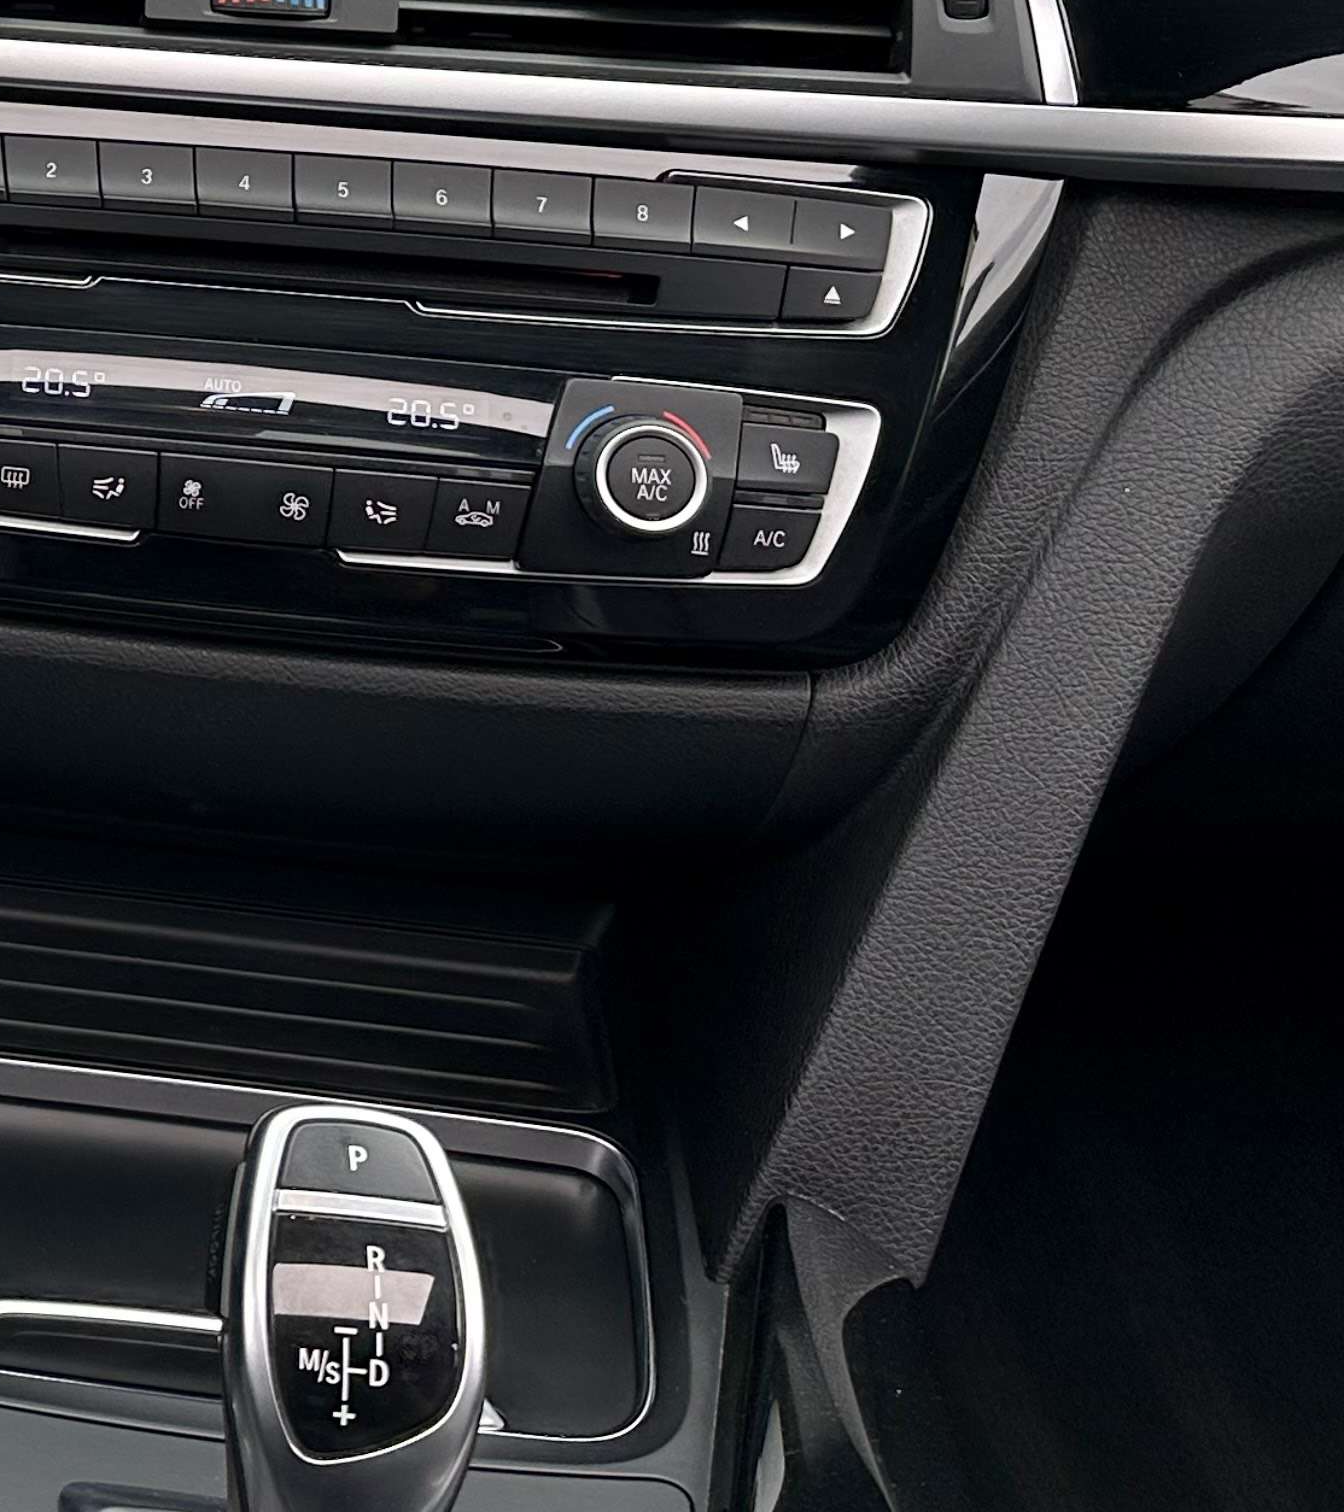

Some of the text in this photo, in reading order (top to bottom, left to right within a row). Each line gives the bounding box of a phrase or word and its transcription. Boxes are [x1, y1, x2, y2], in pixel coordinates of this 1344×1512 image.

[45, 161, 58, 179] 2
[141, 167, 154, 185] 3
[237, 174, 251, 192] 4
[337, 180, 350, 199] 5
[434, 189, 448, 207] 6
[535, 195, 548, 213] 7
[636, 204, 649, 222] 8
[204, 375, 243, 393] AUTO
[630, 467, 672, 488] MAX
[178, 496, 205, 511] OFF
[635, 484, 668, 504] A/C
[752, 528, 787, 550] A/C
[347, 1144, 369, 1172] P
[365, 1245, 386, 1273] R
[368, 1301, 389, 1331] N
[298, 1347, 341, 1385] M/S
[368, 1359, 390, 1388] D
